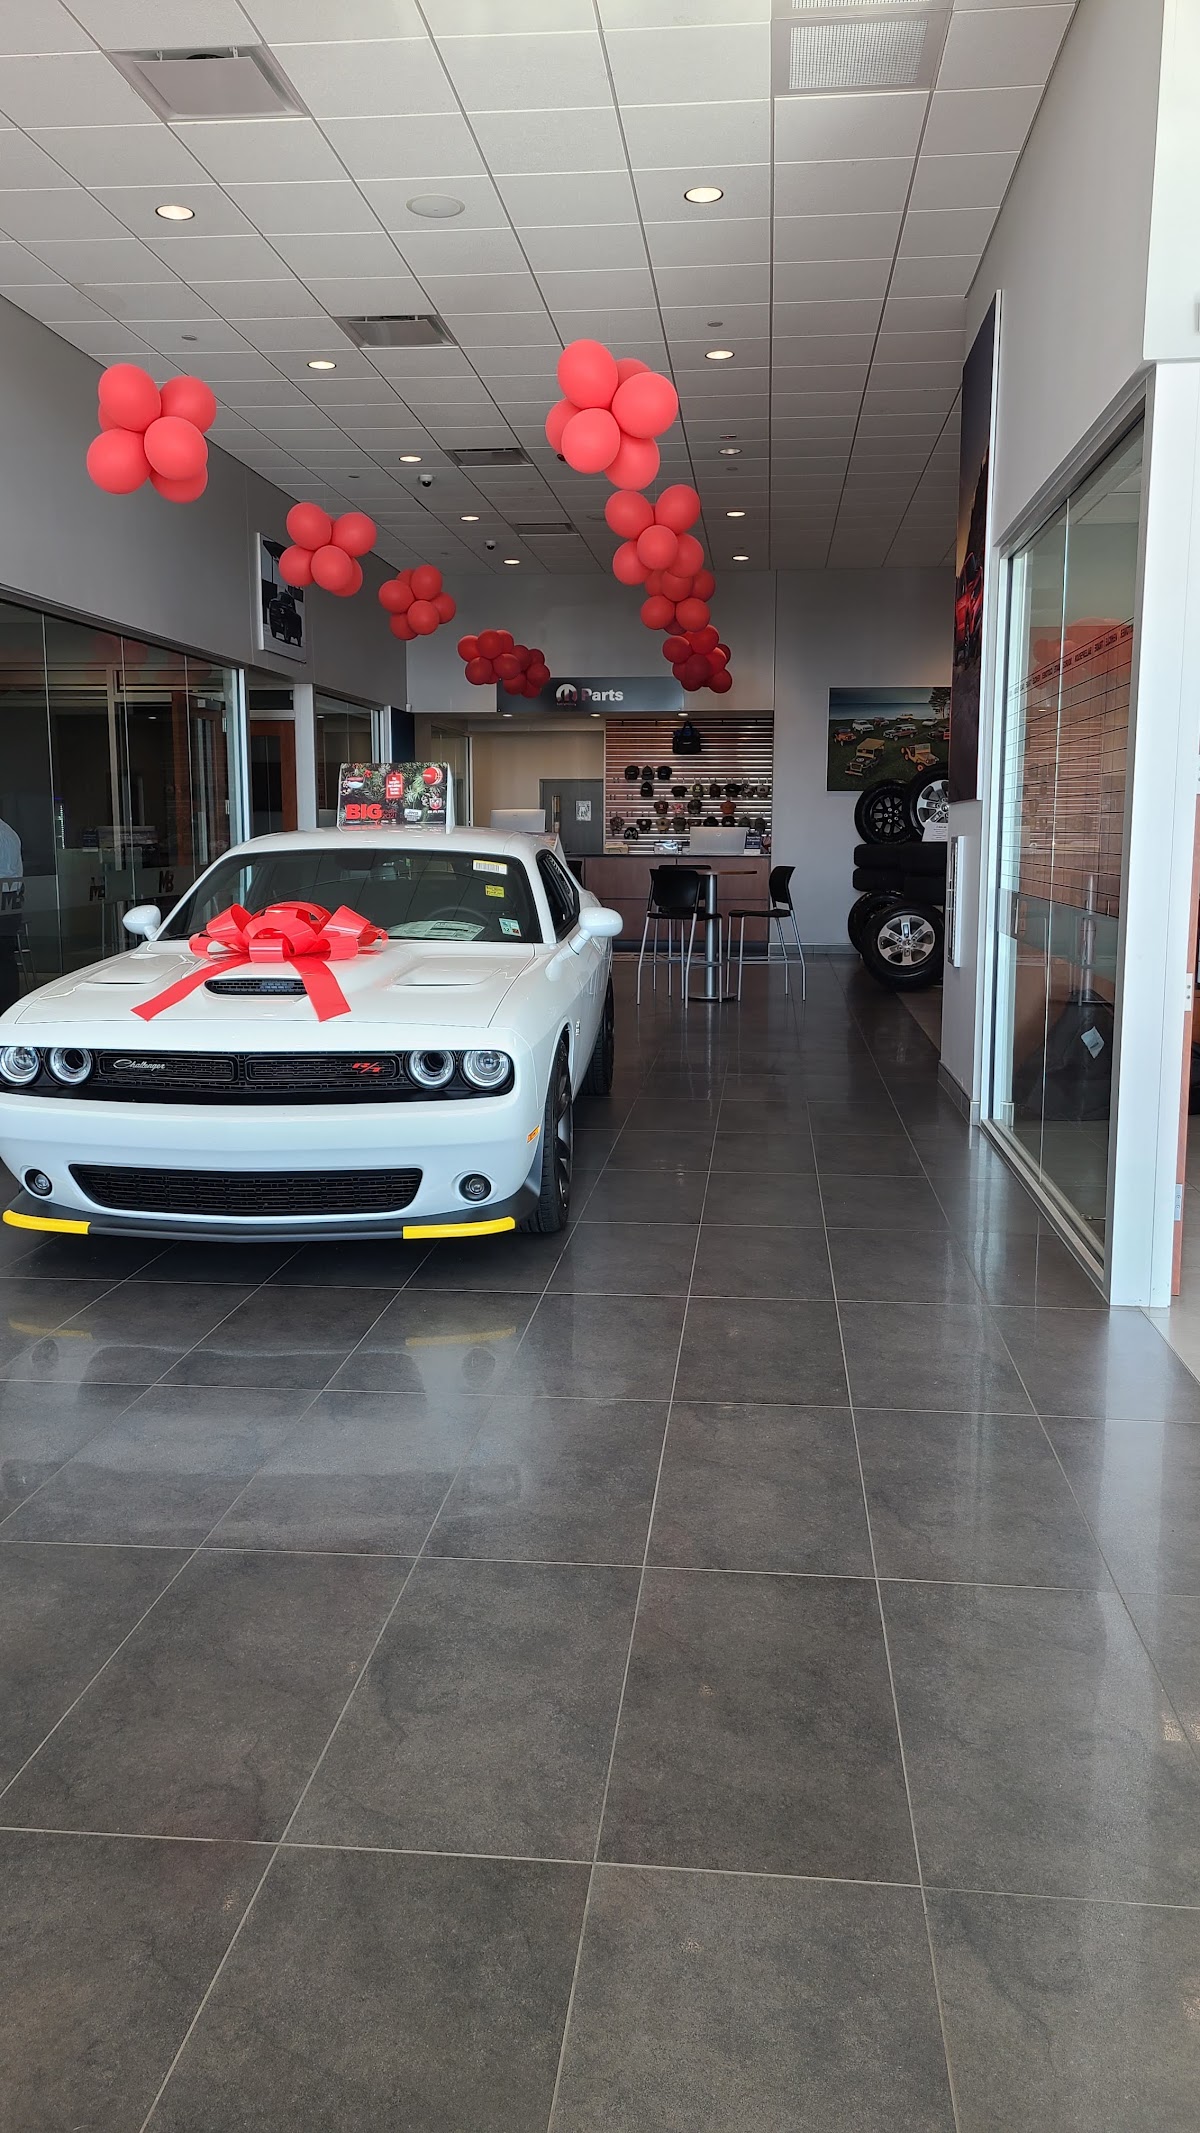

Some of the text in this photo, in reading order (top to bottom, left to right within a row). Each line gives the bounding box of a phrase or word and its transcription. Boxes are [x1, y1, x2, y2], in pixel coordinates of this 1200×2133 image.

[581, 687, 624, 702] Parts
[346, 803, 383, 820] BIG
[113, 1059, 166, 1071] Challenger
